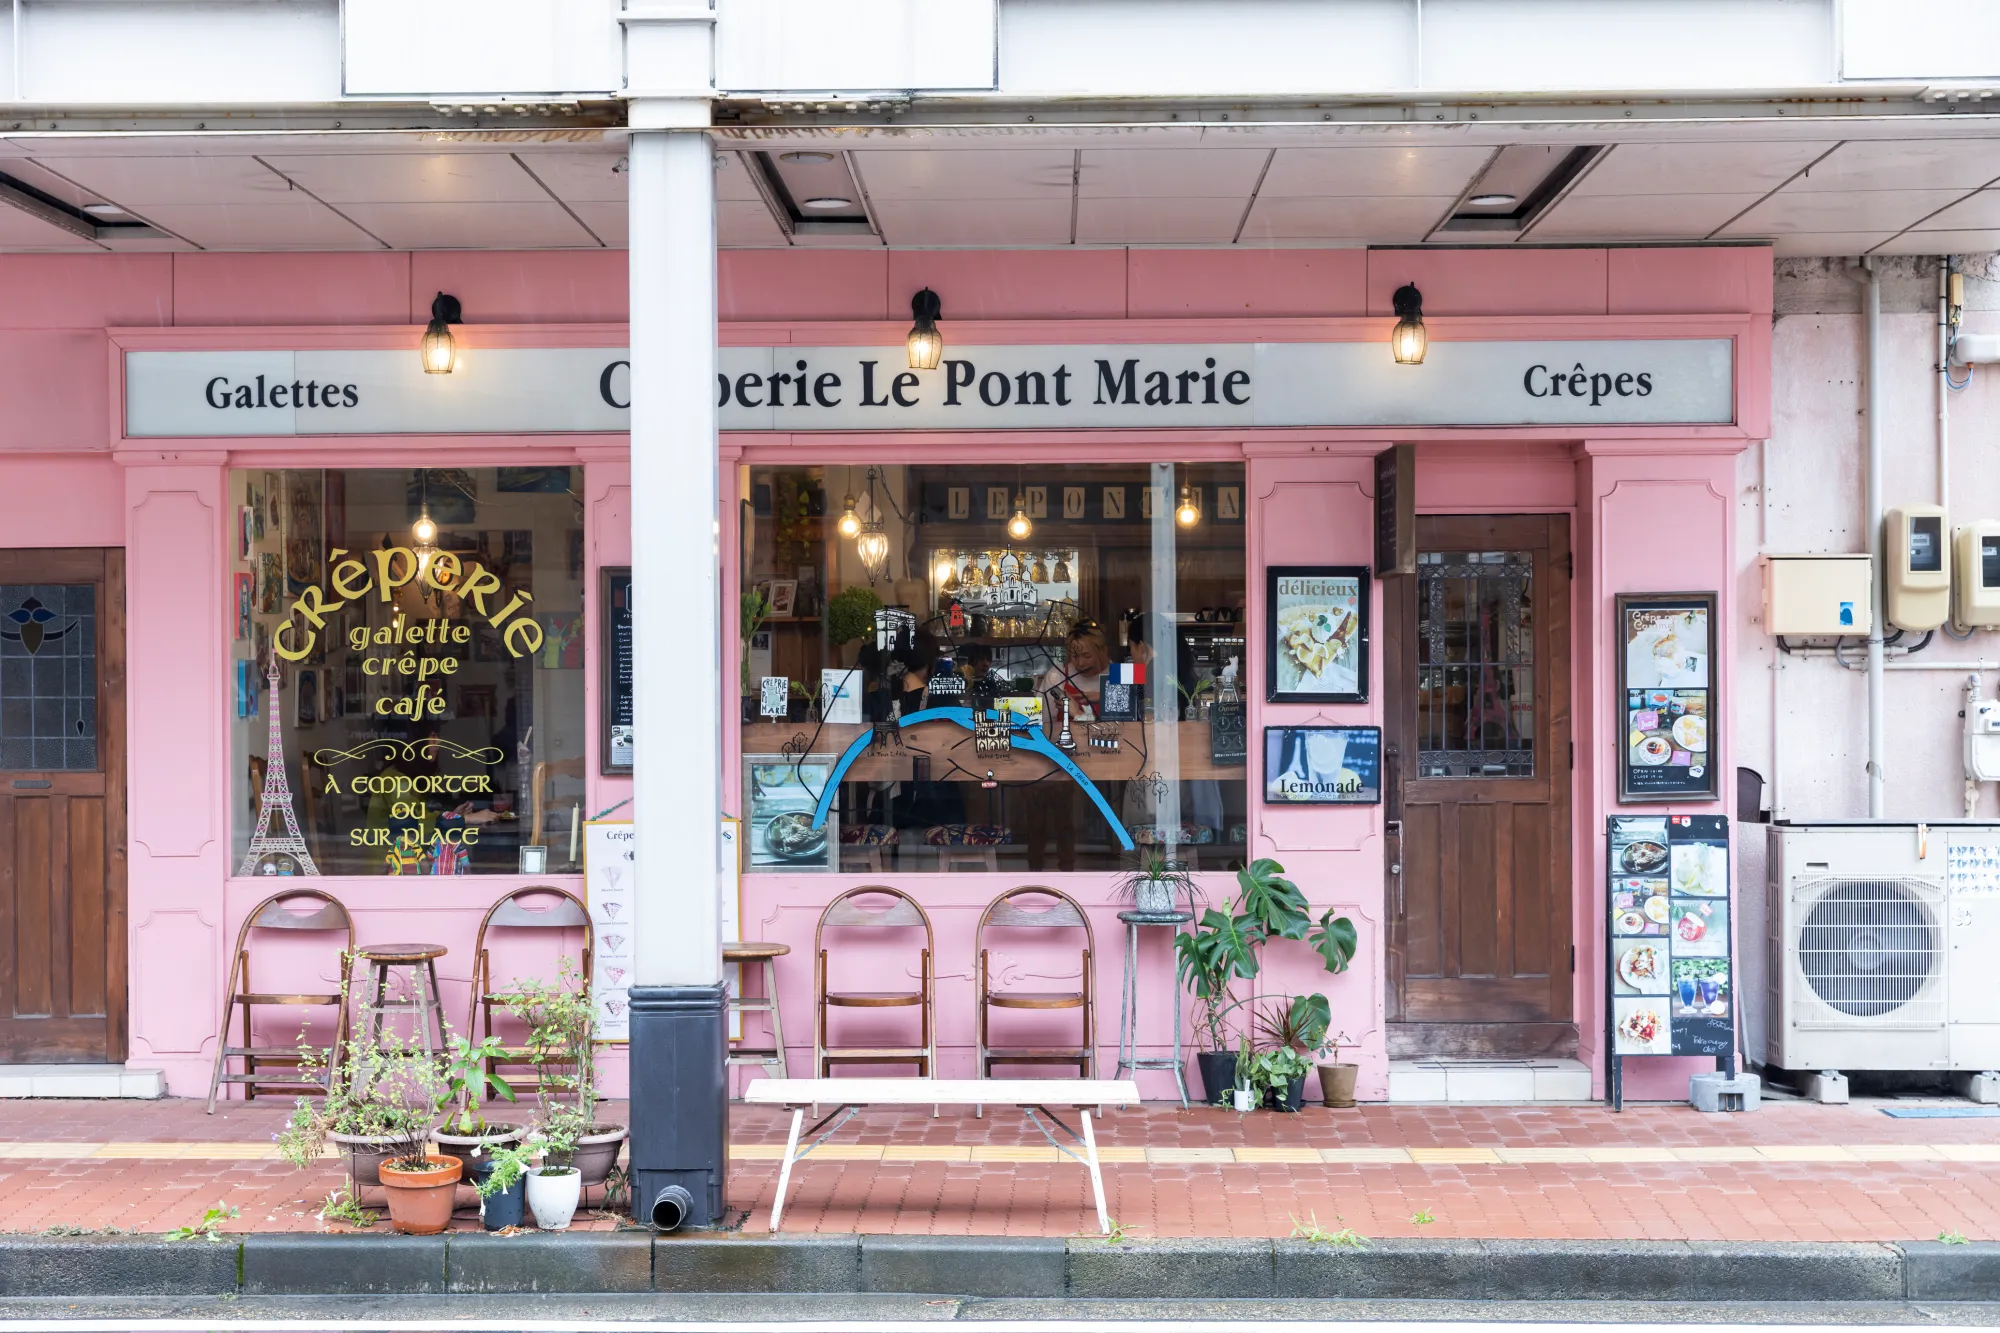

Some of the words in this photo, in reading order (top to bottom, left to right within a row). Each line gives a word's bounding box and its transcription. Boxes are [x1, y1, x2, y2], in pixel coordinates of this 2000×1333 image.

[205, 375, 359, 409] Galettes
[600, 359, 842, 409] Cerie
[858, 360, 920, 407] Le
[942, 358, 1073, 407] Pont
[1094, 357, 1251, 406] Marie
[1523, 362, 1653, 407] Crêpes
[1278, 579, 1358, 597] délicieux
[349, 613, 471, 651] galette
[361, 651, 459, 682] crêpe
[374, 683, 447, 722] café
[350, 774, 494, 798] EMPORTER
[1280, 778, 1364, 794] Lemonade
[390, 801, 427, 820] OU
[350, 827, 393, 846] SUR
